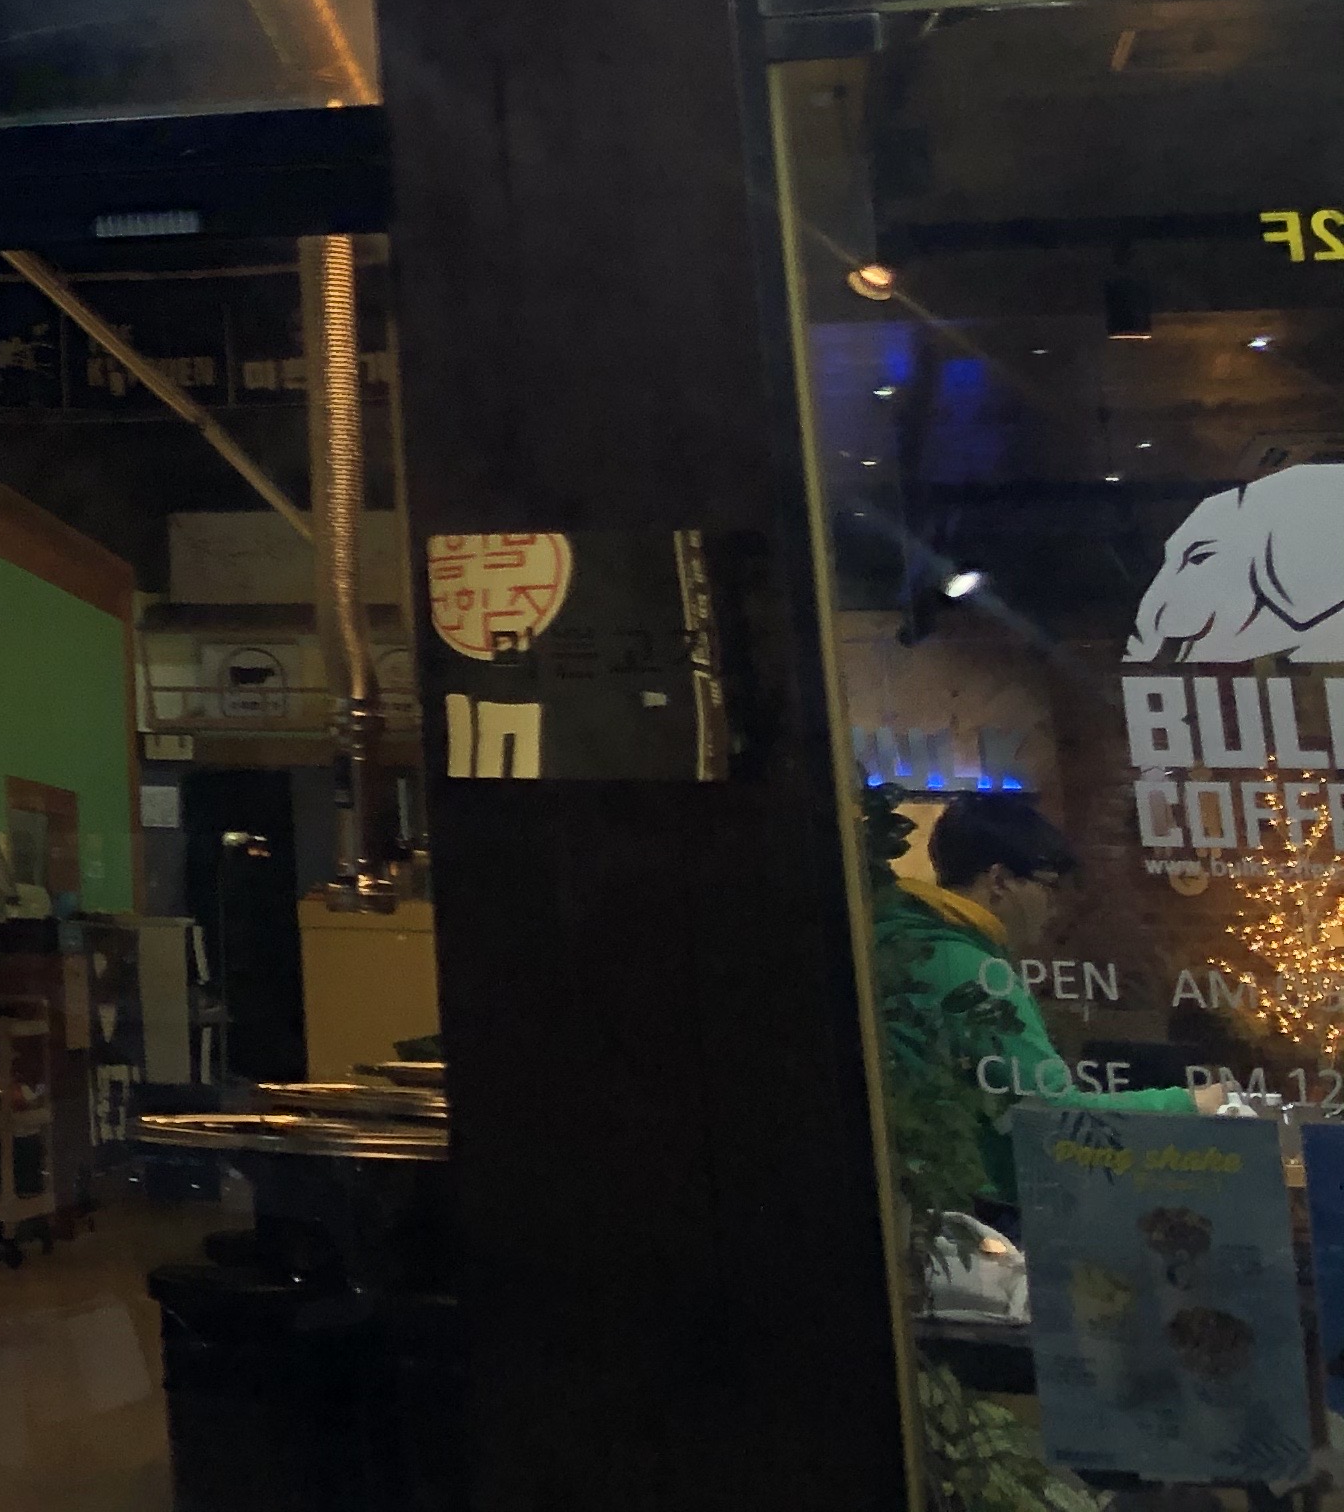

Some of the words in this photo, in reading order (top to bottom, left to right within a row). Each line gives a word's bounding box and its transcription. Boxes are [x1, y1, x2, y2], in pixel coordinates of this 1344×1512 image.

[1121, 675, 1344, 769] BUL
[978, 957, 1121, 1002] OPEN
[1171, 968, 1258, 1011] AM
[976, 1054, 1131, 1097] CLOSE
[1185, 1065, 1268, 1107] PM
